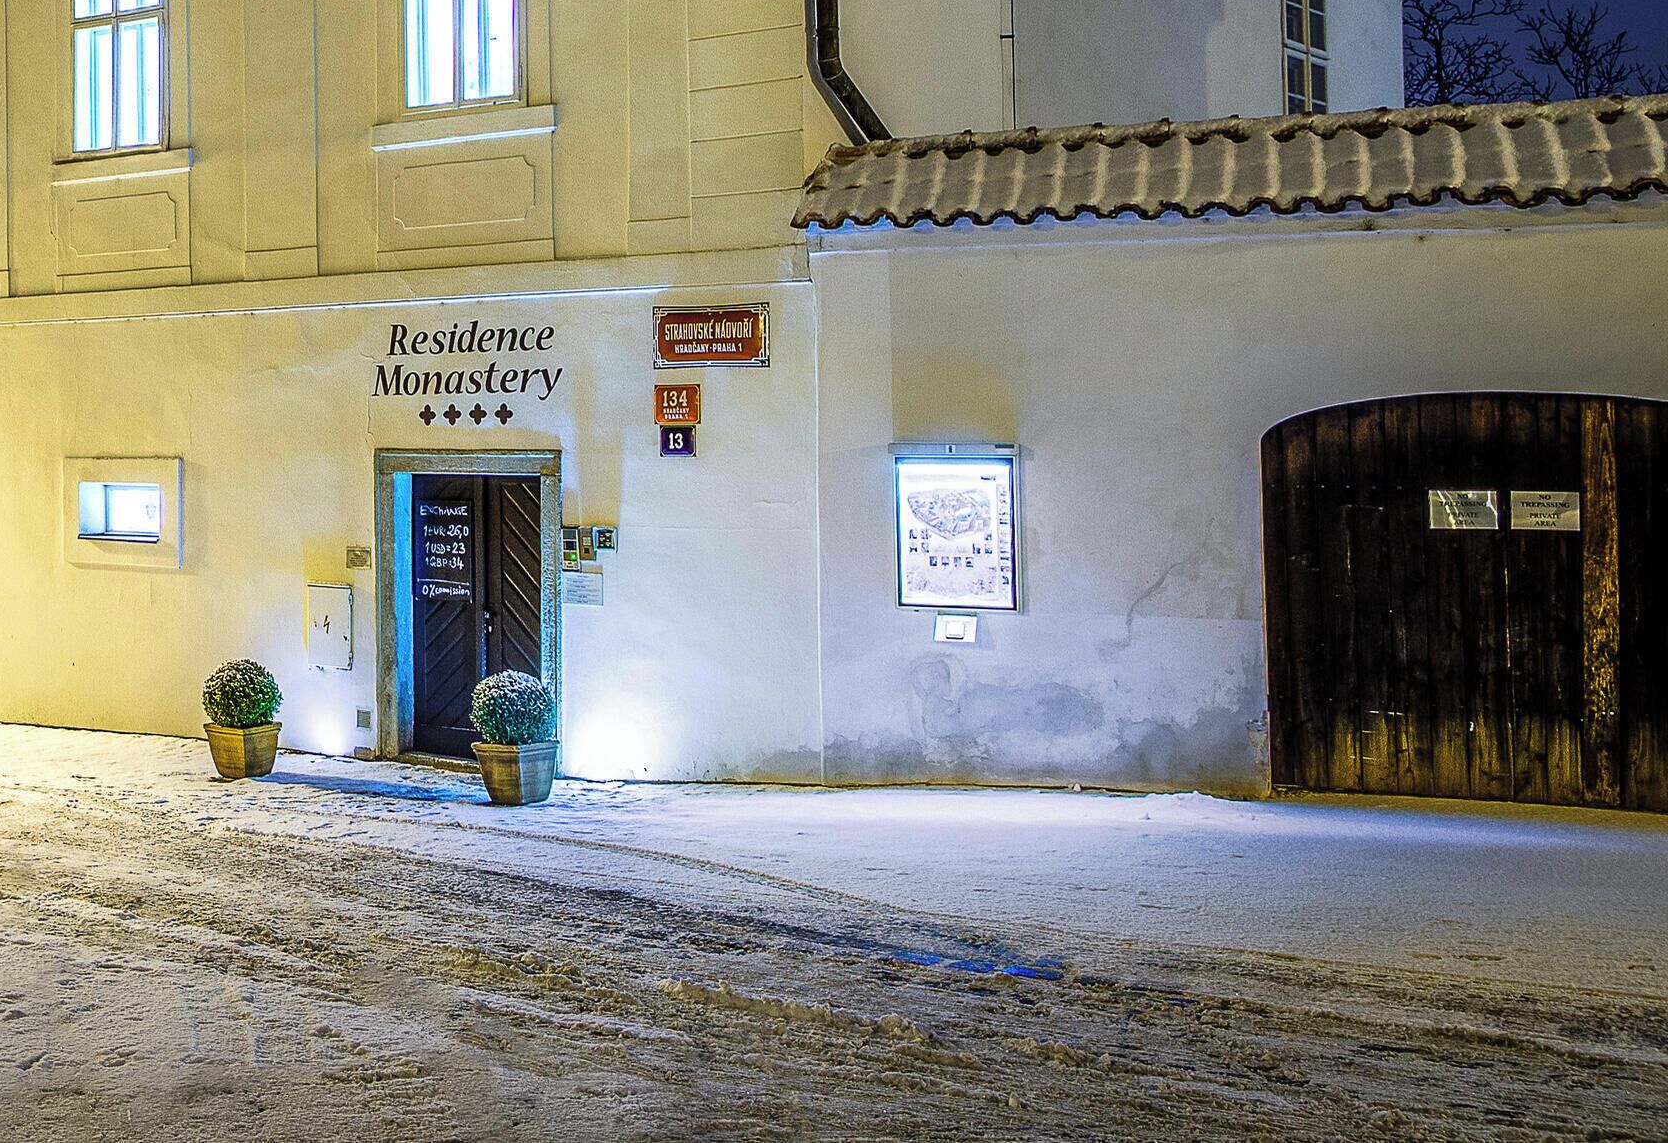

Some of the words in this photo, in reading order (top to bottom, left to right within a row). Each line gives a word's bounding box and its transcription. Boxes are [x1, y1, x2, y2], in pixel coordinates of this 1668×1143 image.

[386, 320, 555, 356] Residence
[664, 319, 714, 340] STRAHOVSKÉ
[715, 318, 753, 339] NÁDVOŘÍ
[737, 343, 743, 352] 1
[372, 361, 563, 401] Monastery
[663, 390, 688, 407] 134
[669, 433, 683, 449] 13
